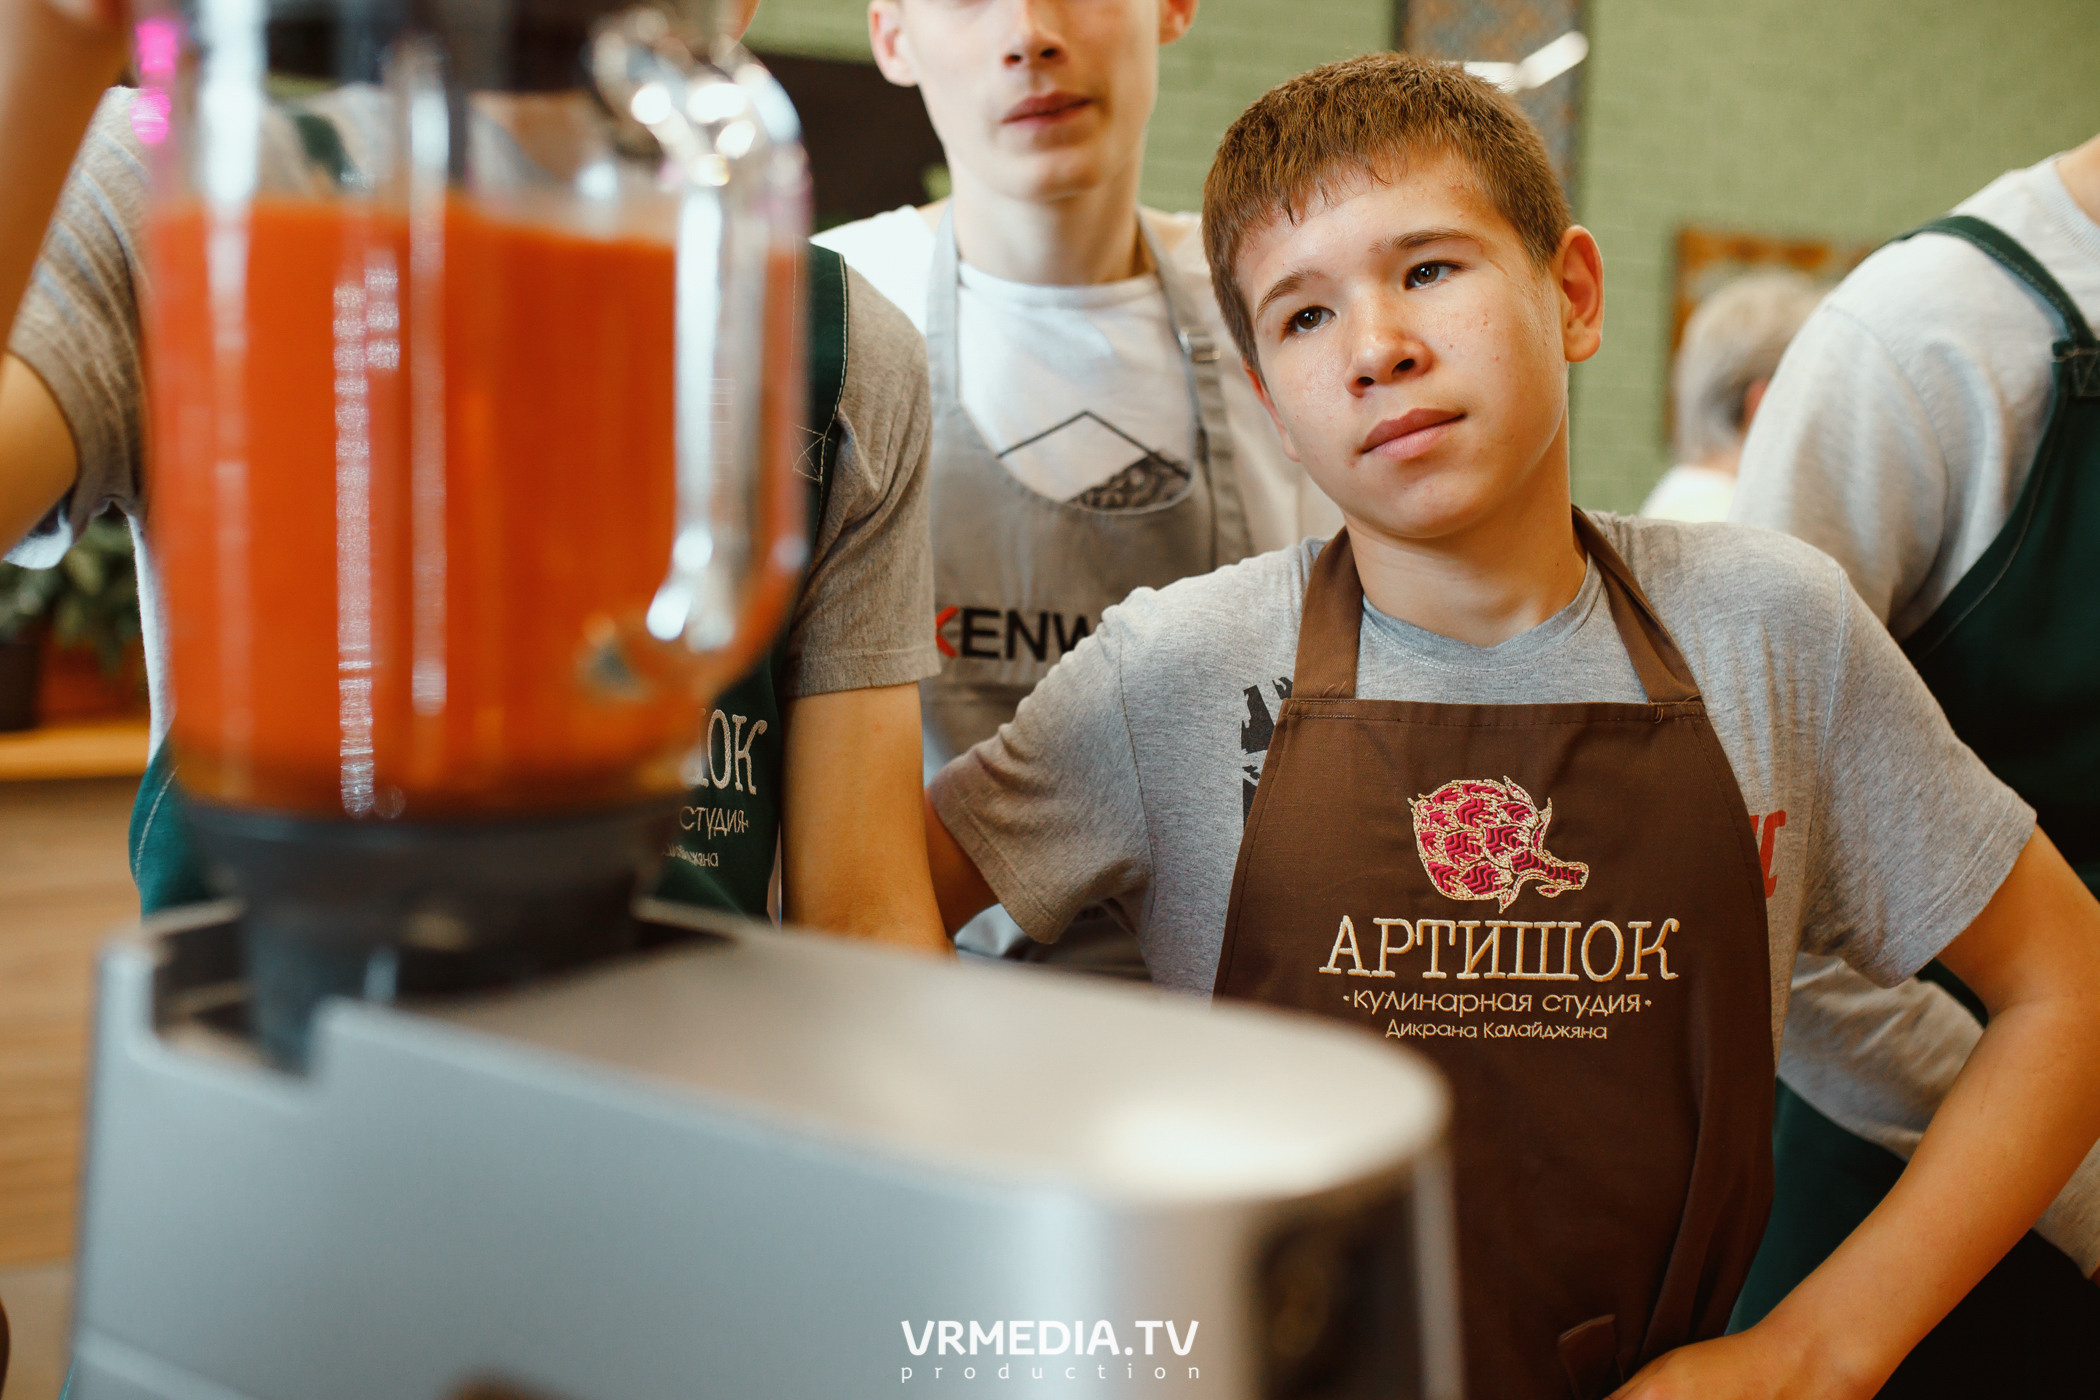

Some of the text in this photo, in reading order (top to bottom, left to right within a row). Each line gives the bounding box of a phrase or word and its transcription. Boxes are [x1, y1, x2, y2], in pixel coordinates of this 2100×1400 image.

[1318, 914, 1680, 981] АРТИШОК
[1385, 1019, 1608, 1040] Дикрана Калайджяна
